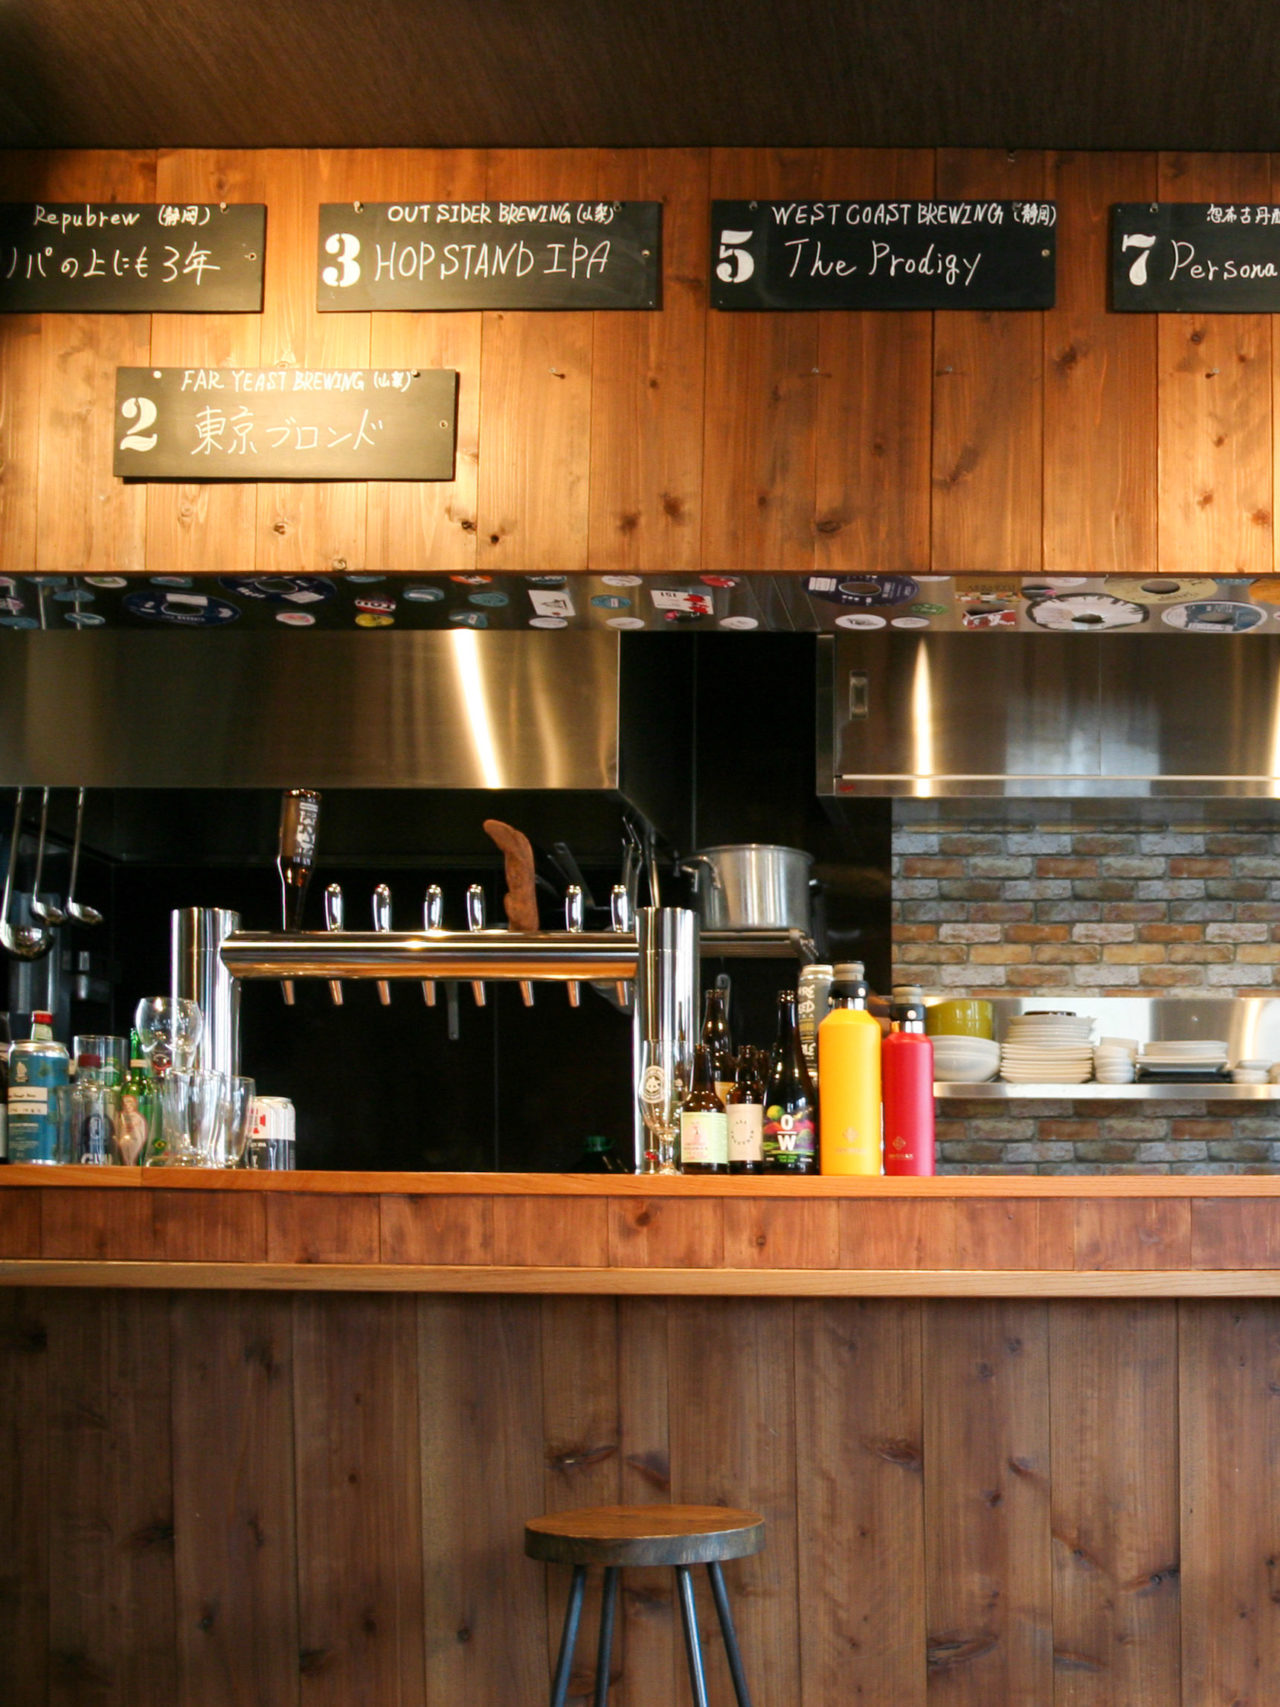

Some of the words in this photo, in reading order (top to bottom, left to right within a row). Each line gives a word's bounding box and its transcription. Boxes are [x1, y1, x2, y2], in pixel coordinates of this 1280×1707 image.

[34, 204, 140, 234] Repubrew
[388, 204, 431, 223] OUT
[436, 204, 492, 224] SIDER
[499, 203, 571, 225] BREWING
[772, 204, 841, 226] WEST
[845, 204, 911, 226] COAST
[917, 203, 1003, 225] BREWING
[322, 233, 361, 287] 3
[544, 238, 611, 280] IPA
[716, 230, 755, 283] 5
[784, 238, 856, 277] The
[869, 240, 981, 286] Prodigy
[1122, 234, 1156, 286] 7
[180, 370, 225, 392] FAR
[232, 370, 287, 392] YEAST
[293, 370, 365, 392] BREWING
[120, 397, 158, 452] 2
[191, 405, 384, 455] 東京ブロンド
